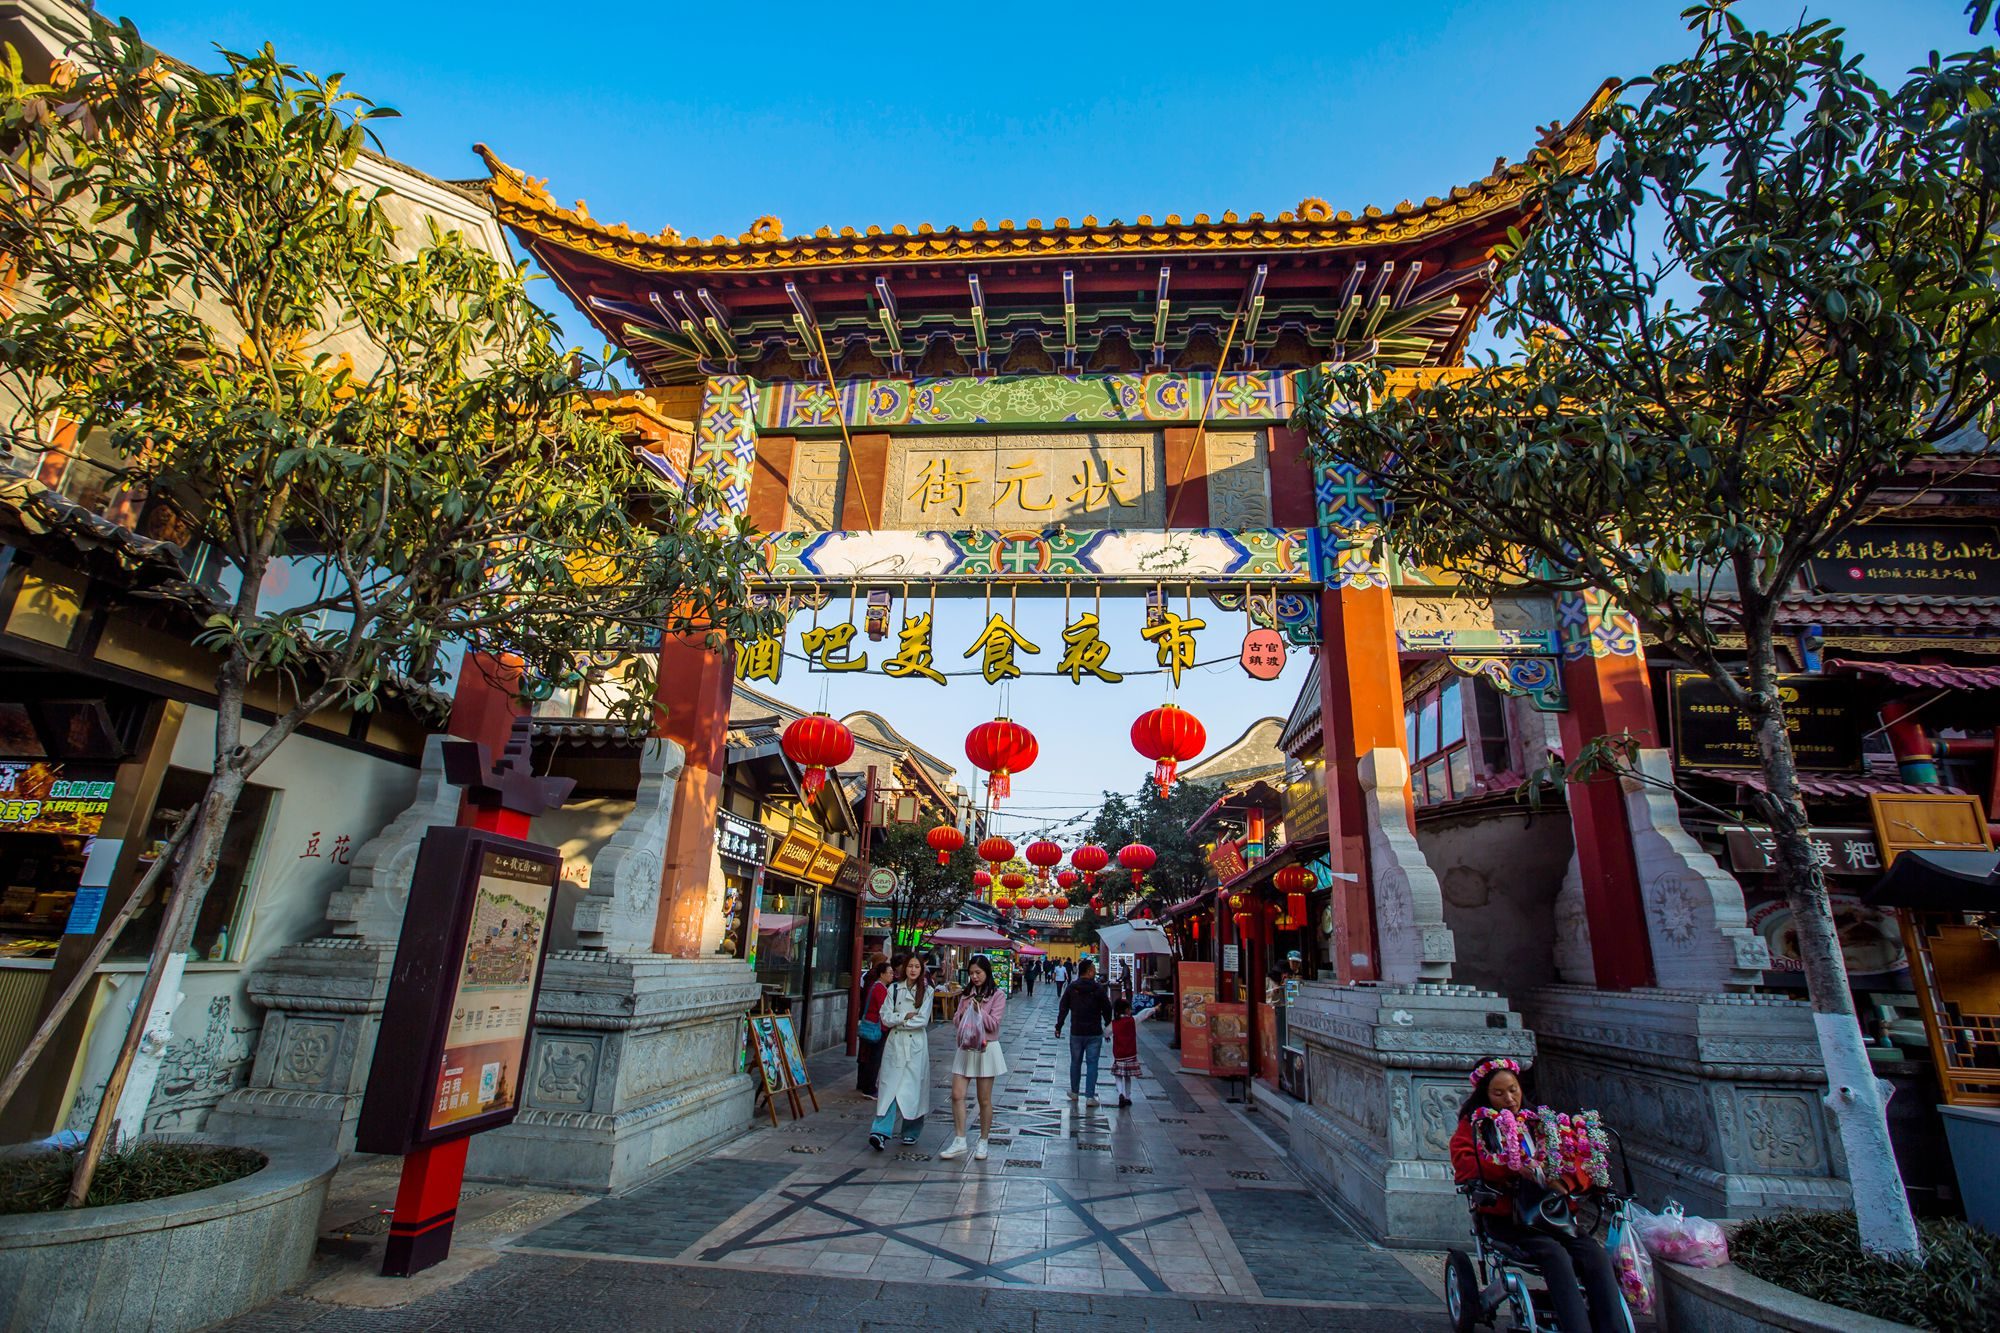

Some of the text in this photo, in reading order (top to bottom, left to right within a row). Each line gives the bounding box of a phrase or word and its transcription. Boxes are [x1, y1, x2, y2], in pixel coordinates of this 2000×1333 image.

[736, 611, 1207, 689] 酒吧美食夜市
[299, 831, 351, 865] 豆花
